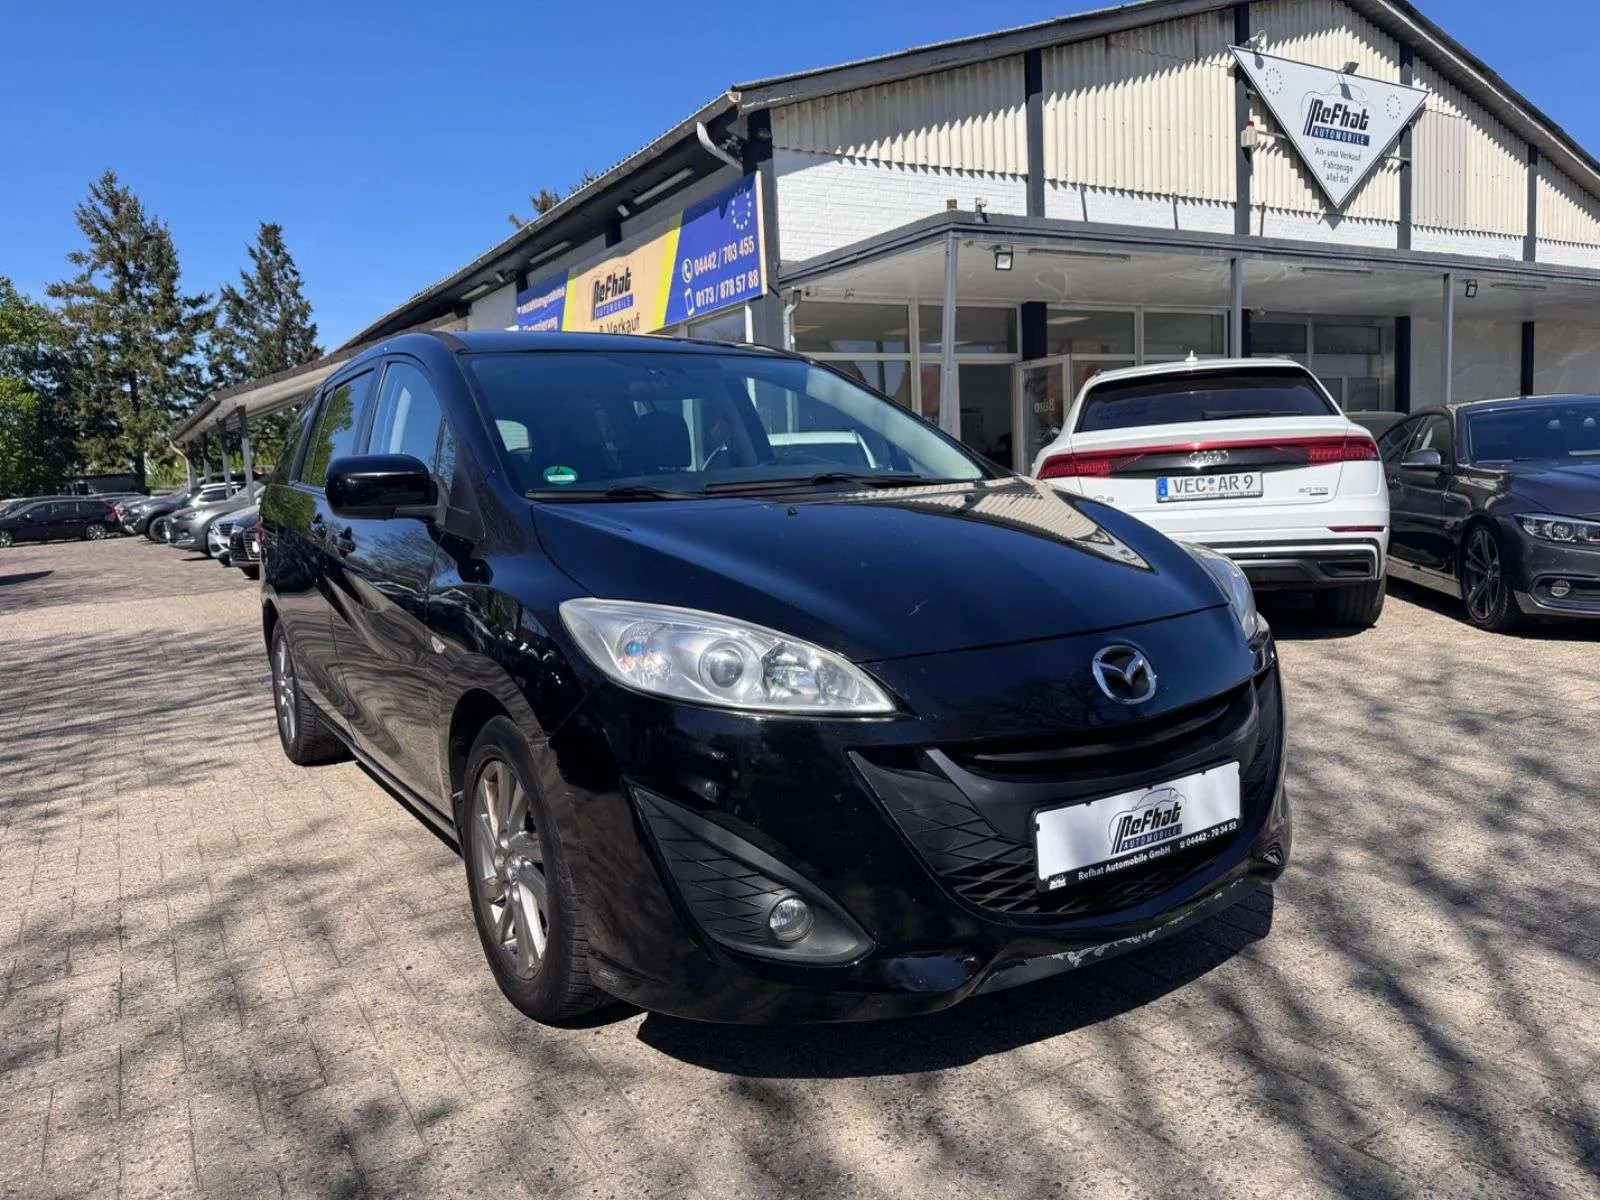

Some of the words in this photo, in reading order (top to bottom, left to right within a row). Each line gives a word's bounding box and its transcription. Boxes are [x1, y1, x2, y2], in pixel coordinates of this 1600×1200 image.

[1313, 126, 1366, 145] AUTOMOBILE
[1327, 149, 1339, 158] und
[1340, 150, 1362, 161] Verkauf
[1323, 160, 1353, 174] Fahrzeuge
[694, 251, 717, 276] 04442
[723, 242, 737, 264] 703
[739, 235, 755, 257] 455
[696, 286, 715, 307] 0173
[720, 279, 735, 299] 878
[736, 273, 746, 294] 57
[748, 269, 759, 289] 88
[607, 312, 640, 334] Verkauf
[1173, 477, 1206, 493] VEC
[1219, 475, 1239, 491] AR
[1244, 474, 1253, 490] 9
[1123, 827, 1178, 850] AUTOMOBILE
[1078, 866, 1104, 881] Refhat
[1105, 853, 1147, 873] Automobile
[1149, 845, 1171, 859] GmbH
